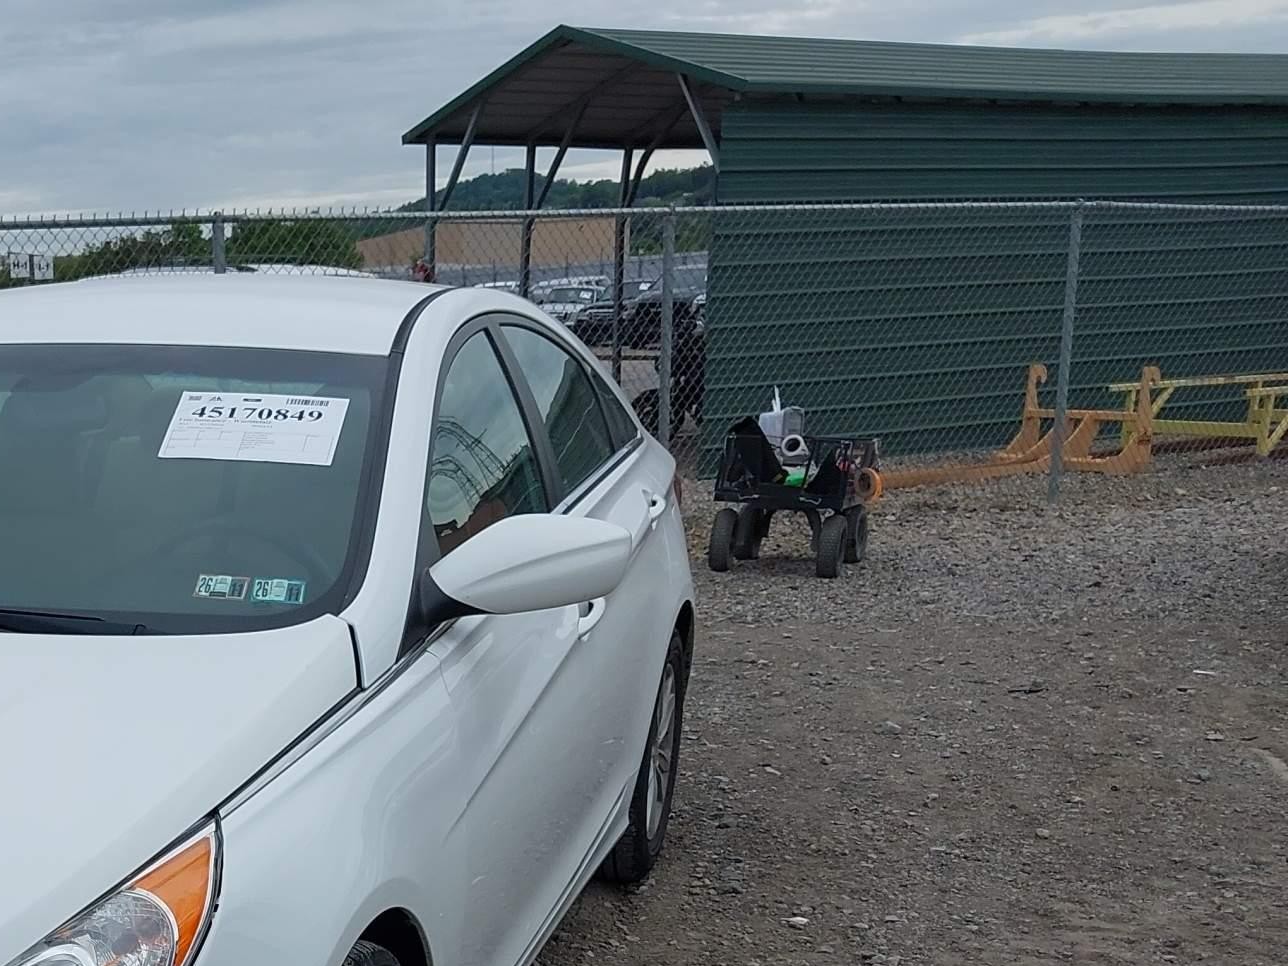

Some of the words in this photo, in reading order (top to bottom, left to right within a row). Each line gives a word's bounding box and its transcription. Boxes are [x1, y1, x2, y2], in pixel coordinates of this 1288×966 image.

[191, 405, 324, 422] 45170849
[198, 577, 213, 593] 26
[255, 581, 269, 597] 26
